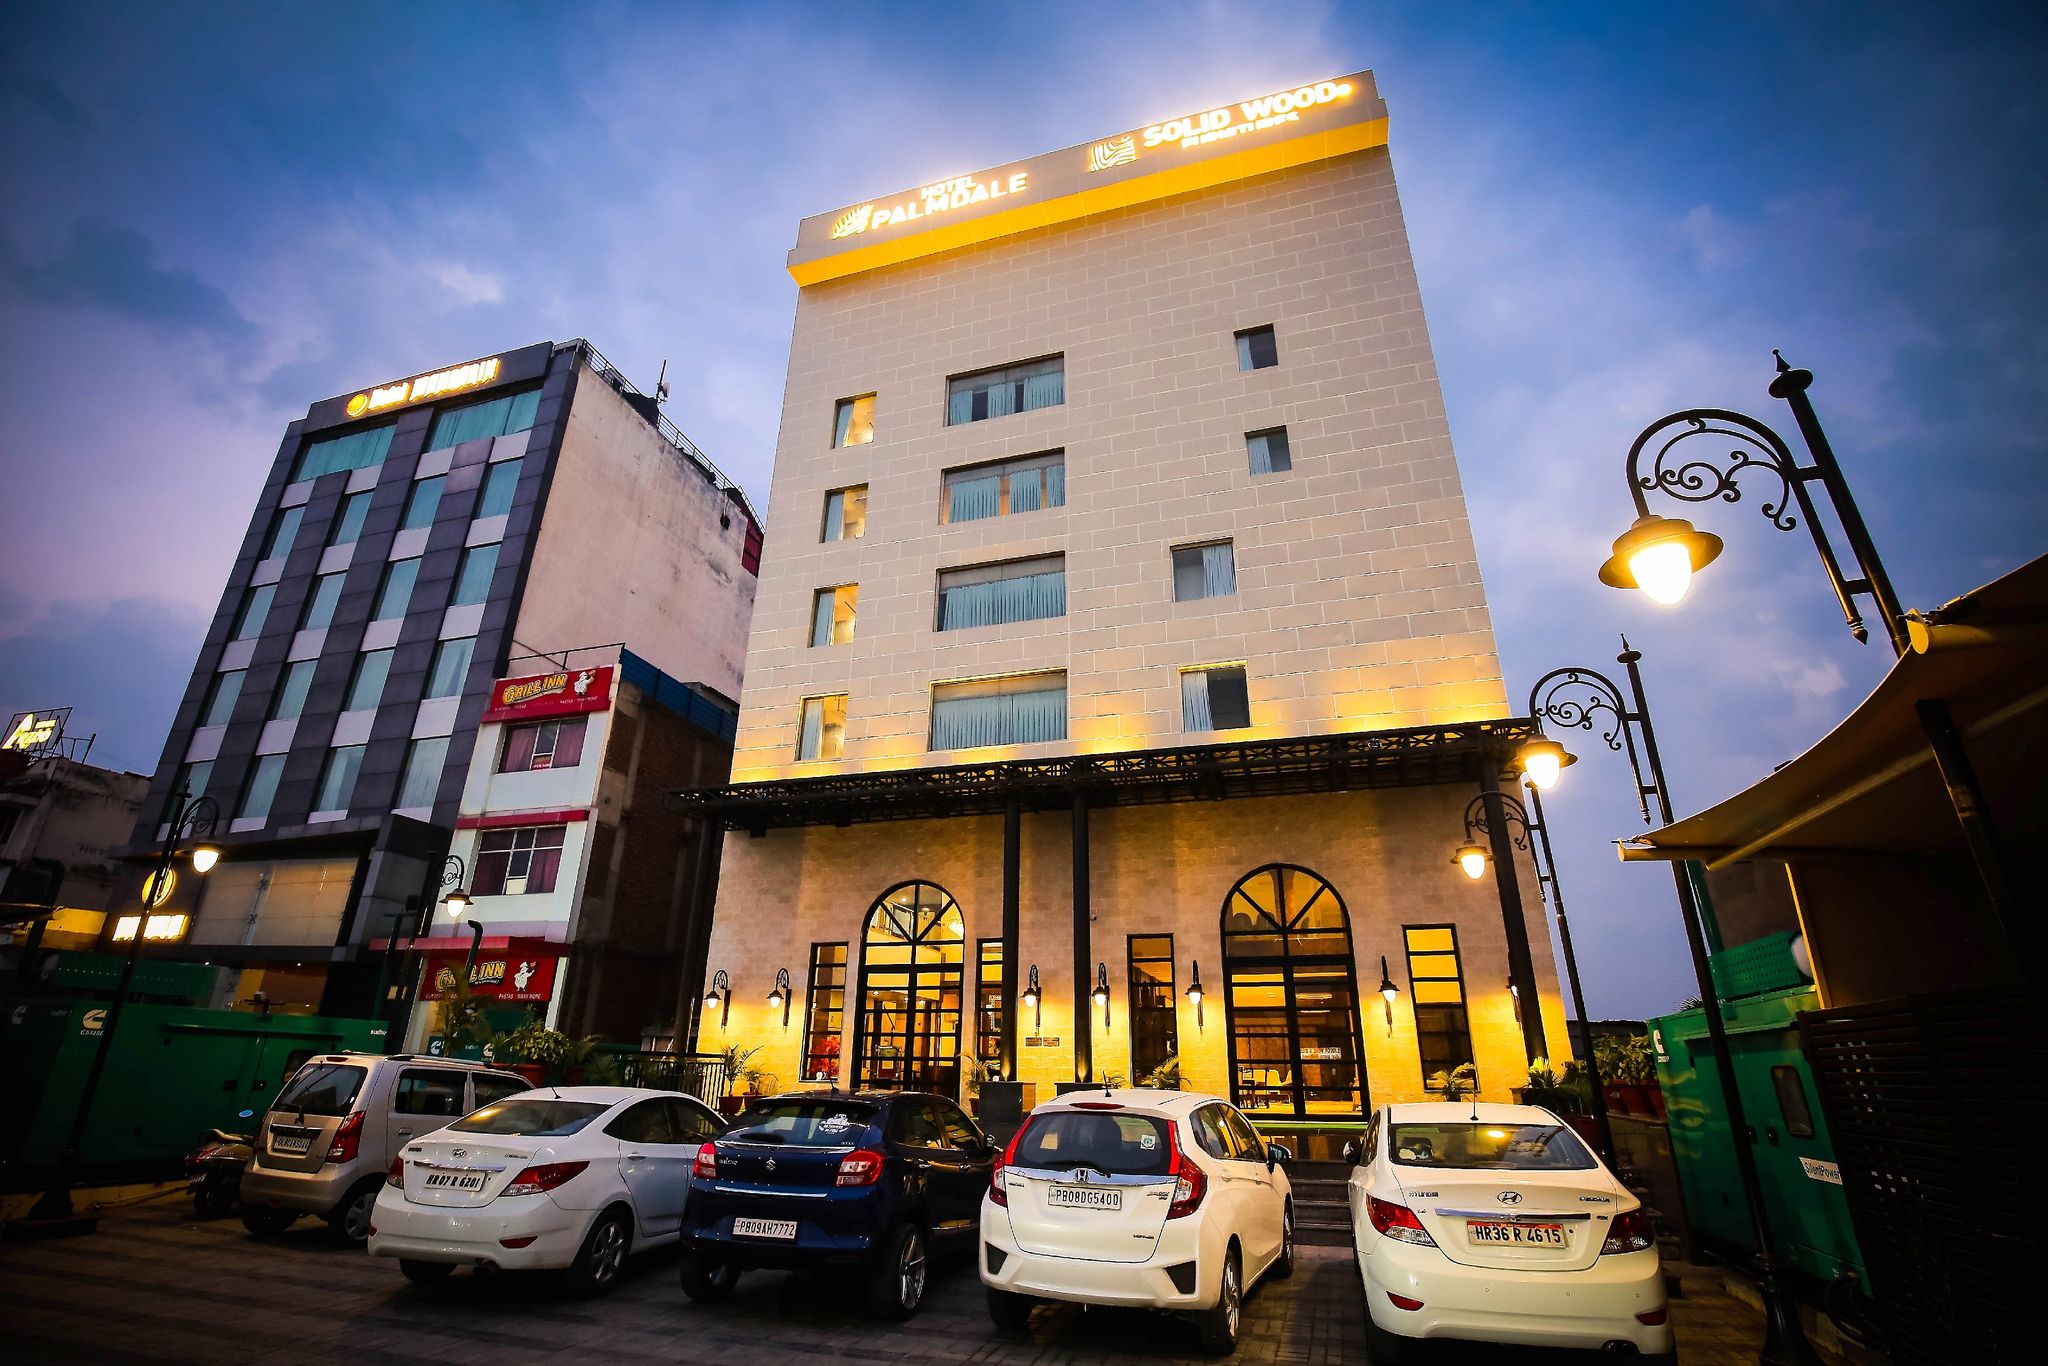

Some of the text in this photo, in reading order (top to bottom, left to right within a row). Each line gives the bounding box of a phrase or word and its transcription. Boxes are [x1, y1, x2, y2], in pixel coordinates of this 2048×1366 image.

[1144, 109, 1231, 148] SOLID
[1241, 81, 1337, 121] WOOD
[920, 176, 976, 201] HOTEL
[871, 171, 1028, 231] PALMDALE
[502, 673, 569, 704] GRILL INN
[480, 960, 506, 981] INN
[426, 1174, 481, 1190] HR07 R 6201
[1056, 1189, 1119, 1206] PB08DG5400
[739, 1221, 795, 1236] PB09AH7772
[1475, 1226, 1561, 1244] HR36 R 4615
